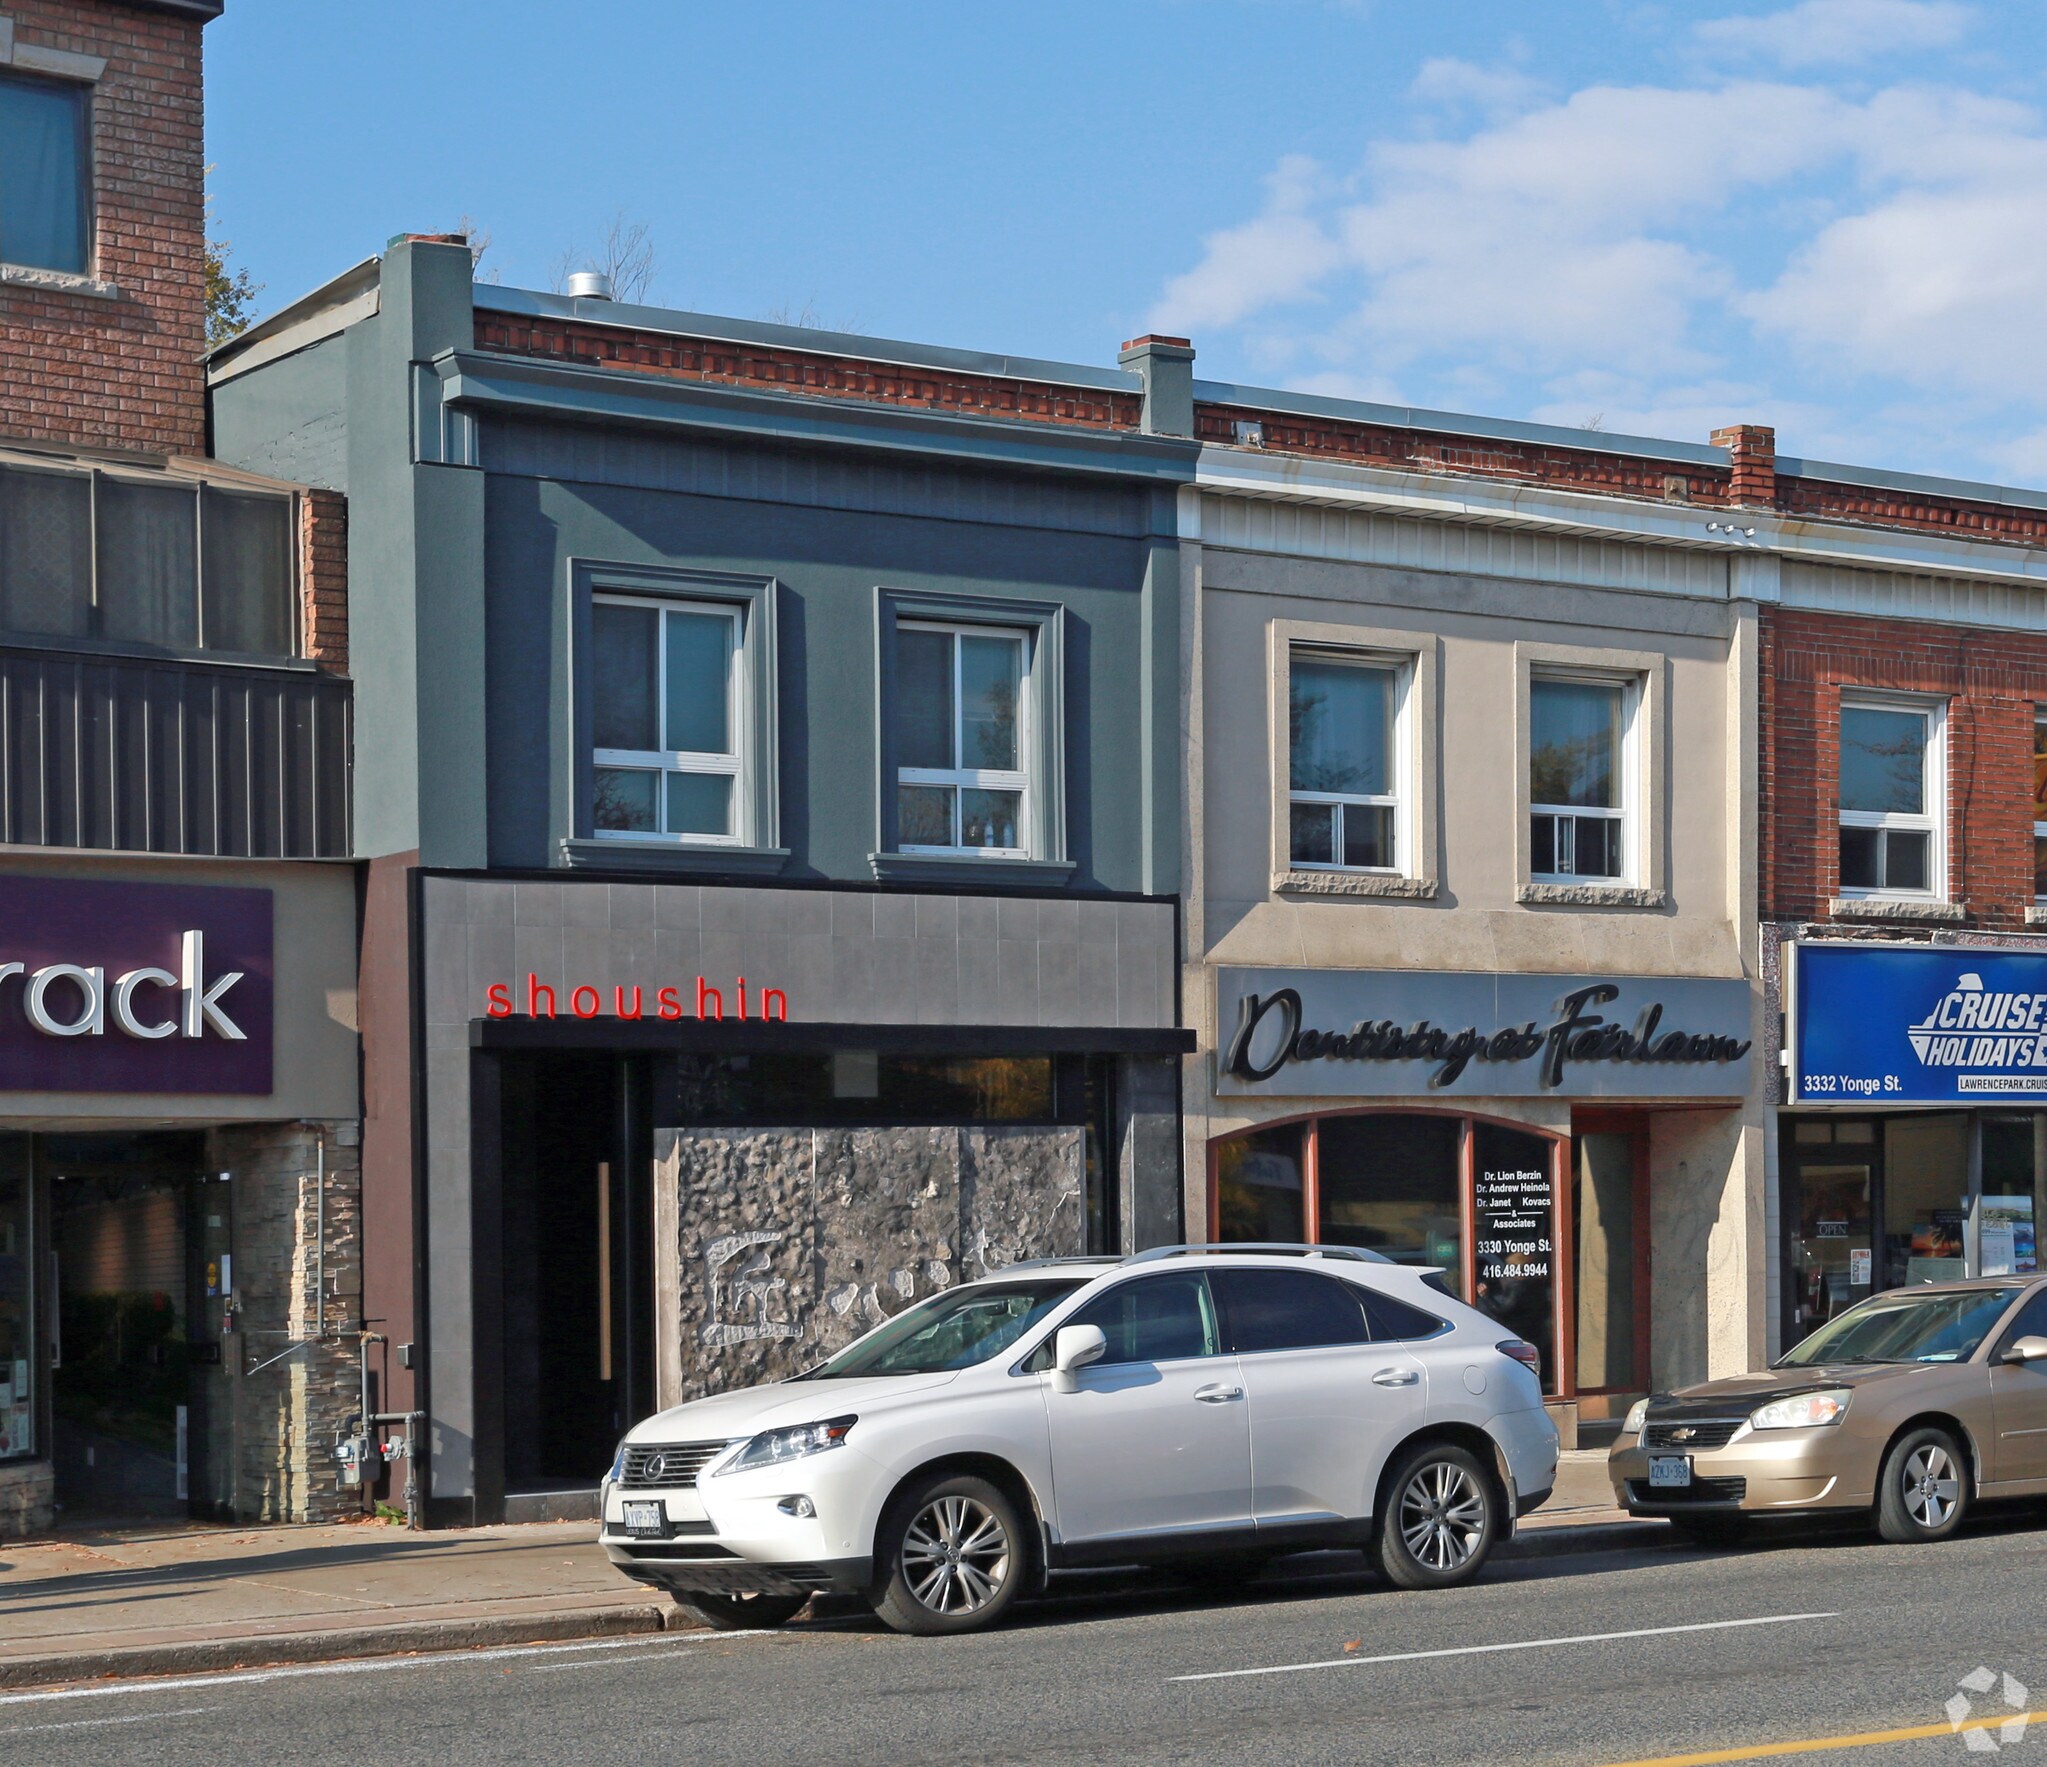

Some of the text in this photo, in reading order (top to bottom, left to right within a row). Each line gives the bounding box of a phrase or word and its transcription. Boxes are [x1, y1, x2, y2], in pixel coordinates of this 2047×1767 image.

[486, 972, 787, 1022] shoushin
[1938, 992, 2047, 1030] CRUISE
[1220, 984, 1752, 1089] Dentistry at Fairlawn
[1926, 1037, 2035, 1067] HOLIDAYS
[1804, 1074, 1903, 1096] 3332 Yonge St.
[1484, 1170, 1542, 1181] Dr. Lion Berzin
[1476, 1182, 1550, 1193] Dr. Andrew Heinola
[1476, 1197, 1551, 1207] Dr. Janet Kovacs
[1511, 1209, 1518, 1217] &
[1493, 1219, 1536, 1228] Associates
[1819, 1224, 1846, 1235] OPEN
[1477, 1238, 1552, 1256] 3330 Yonge St.
[1482, 1263, 1548, 1278] 416.484.9944
